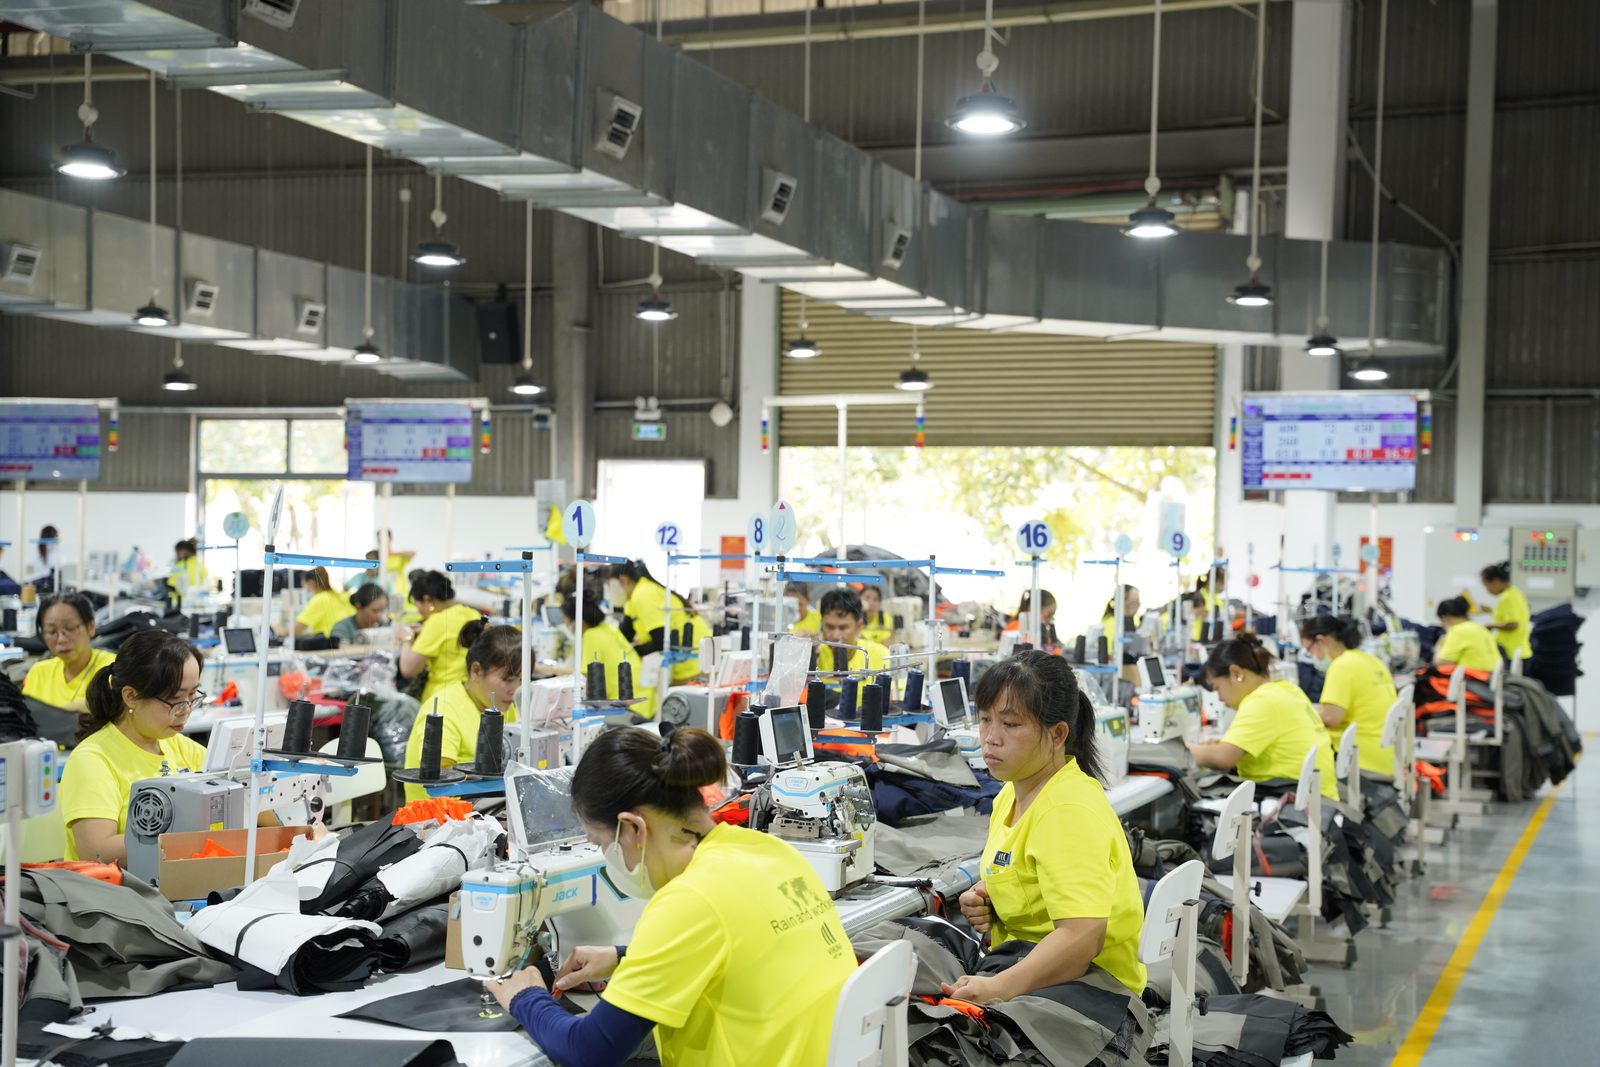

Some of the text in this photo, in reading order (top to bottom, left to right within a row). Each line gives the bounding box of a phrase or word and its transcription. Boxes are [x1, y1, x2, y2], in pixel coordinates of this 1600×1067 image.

[572, 505, 583, 536] 1
[754, 517, 763, 543] 8
[657, 526, 677, 545] 12
[1020, 523, 1048, 548] 16
[1172, 533, 1184, 551] 9
[770, 915, 798, 934] Rain
[796, 908, 813, 924] and
